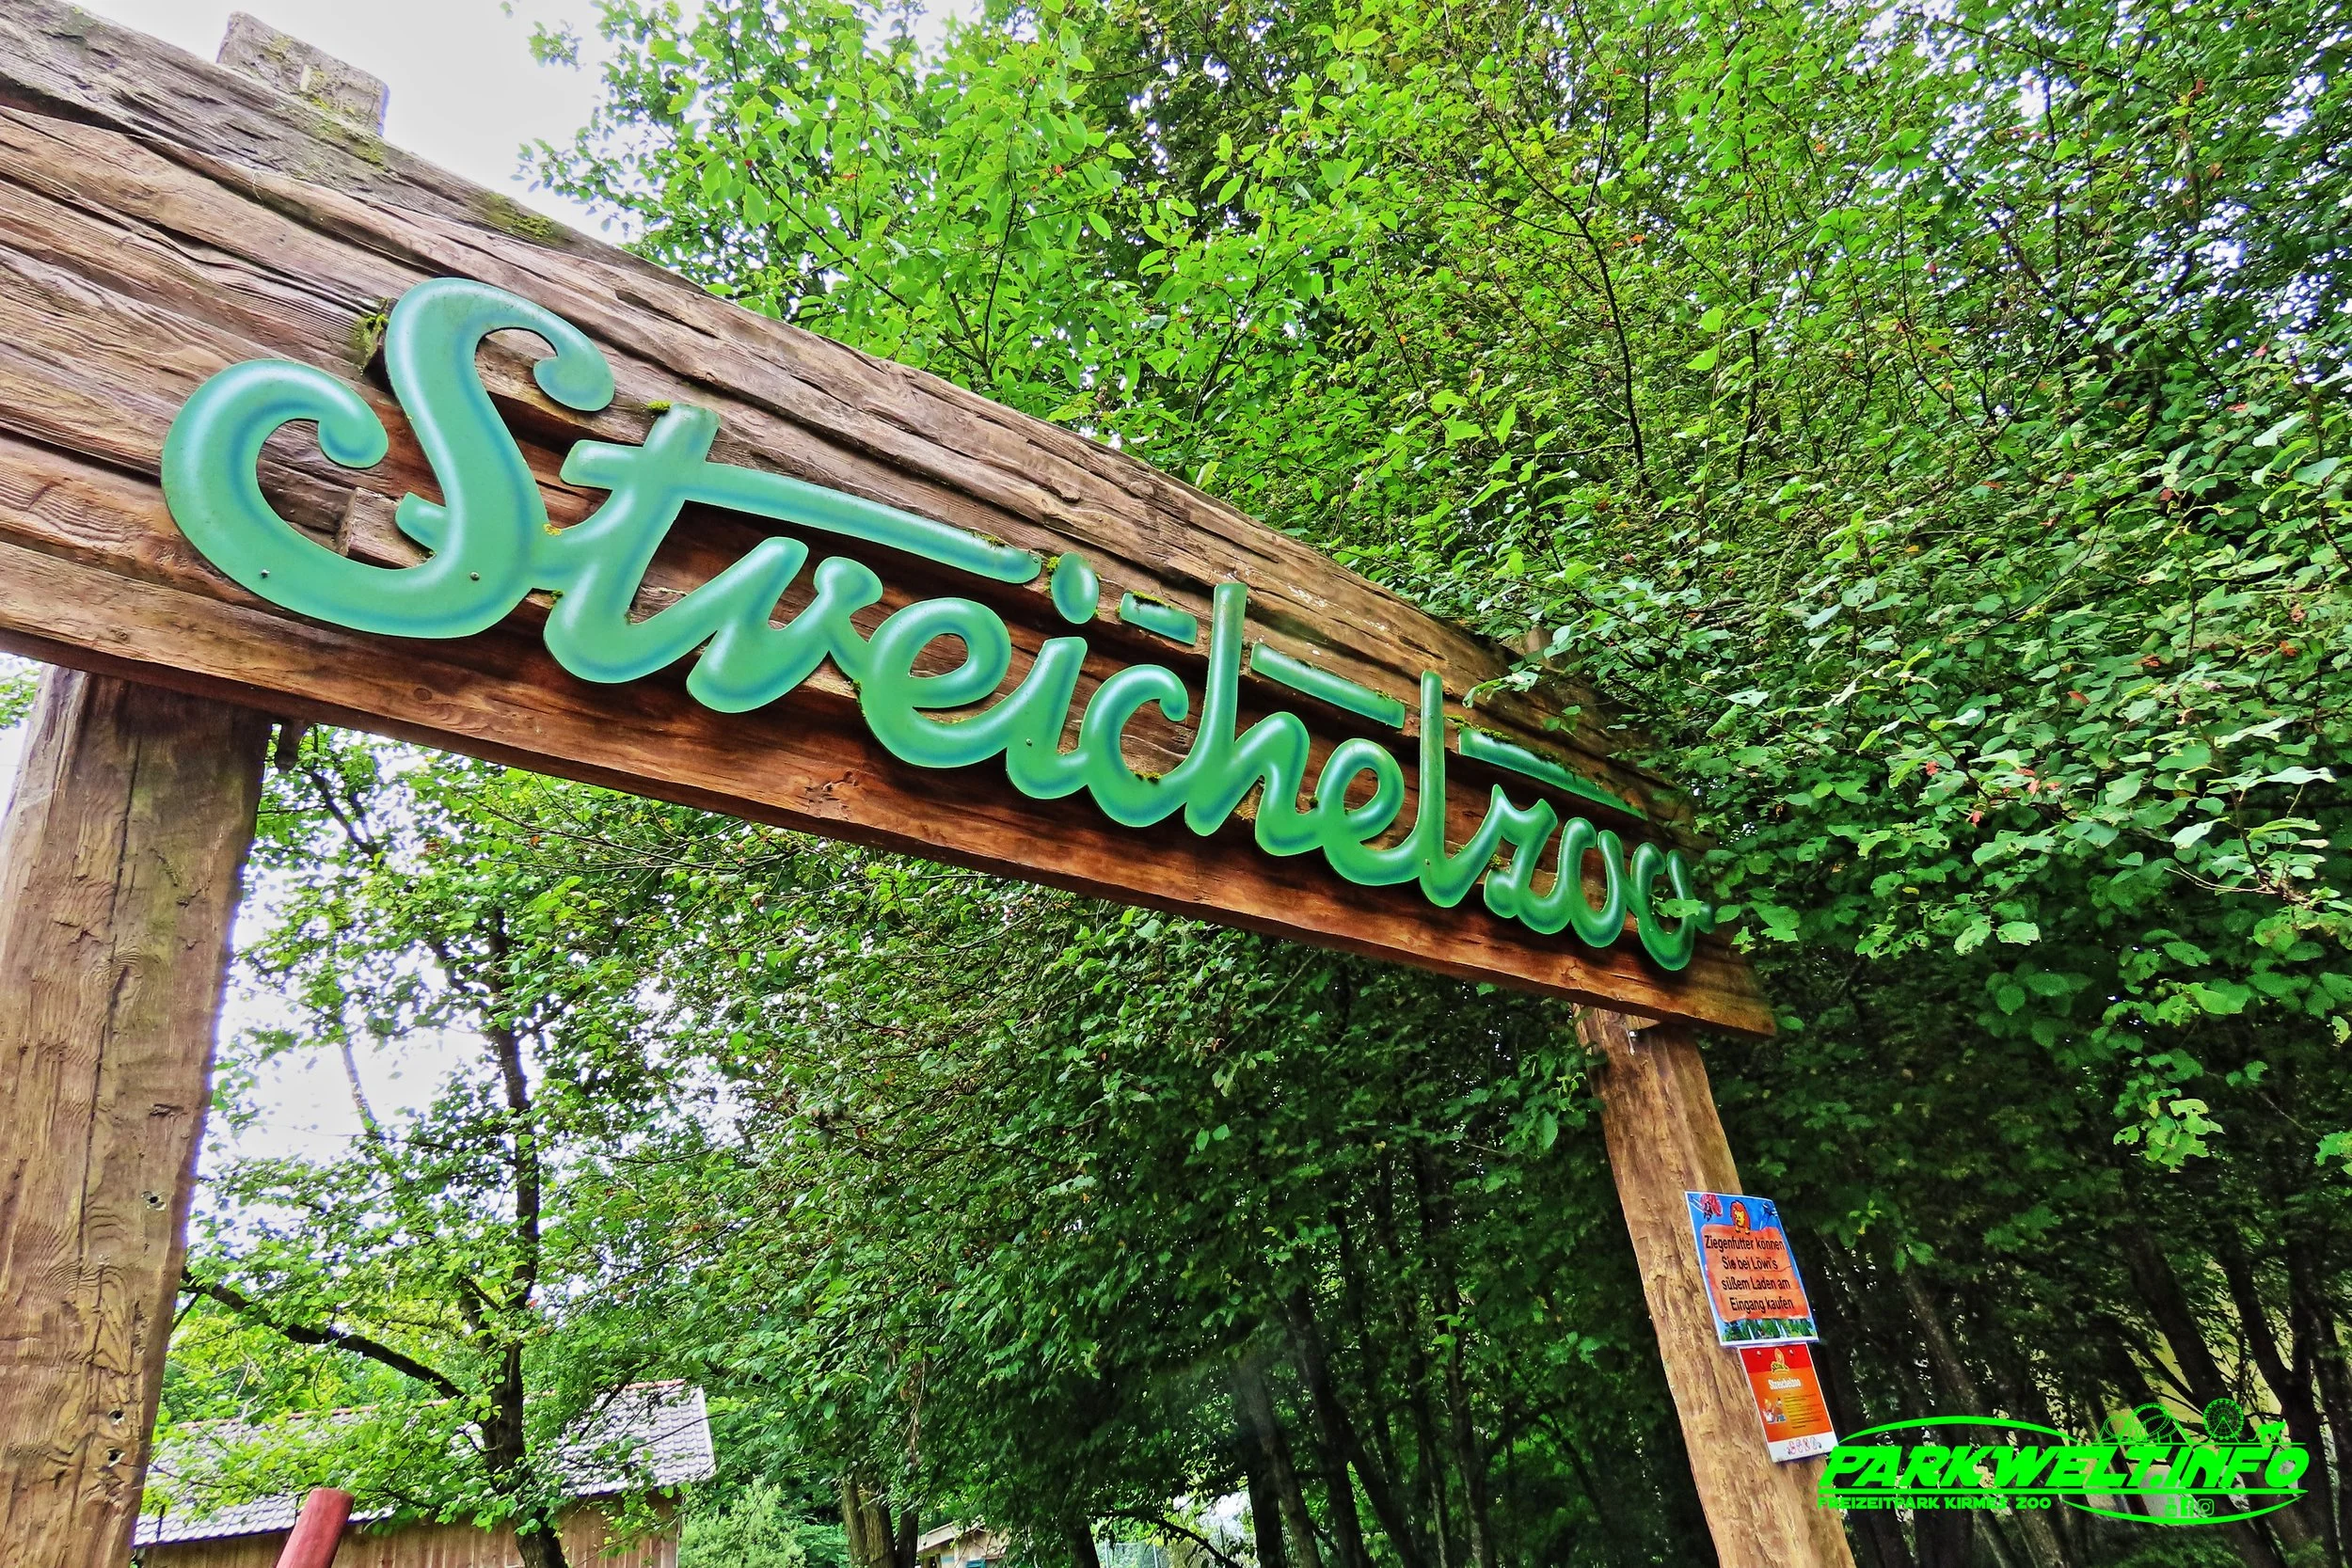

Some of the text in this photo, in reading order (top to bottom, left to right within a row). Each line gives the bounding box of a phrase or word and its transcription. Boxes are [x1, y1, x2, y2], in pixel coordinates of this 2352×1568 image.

[161, 276, 1715, 971] Streichelzoo
[1704, 1235, 1755, 1252] Ziegenfutter
[1722, 1256, 1736, 1270] Sie
[1736, 1256, 1750, 1270] bei
[1721, 1276, 1791, 1291] süßem Laden am
[1729, 1296, 1795, 1314] Eingang kaufen
